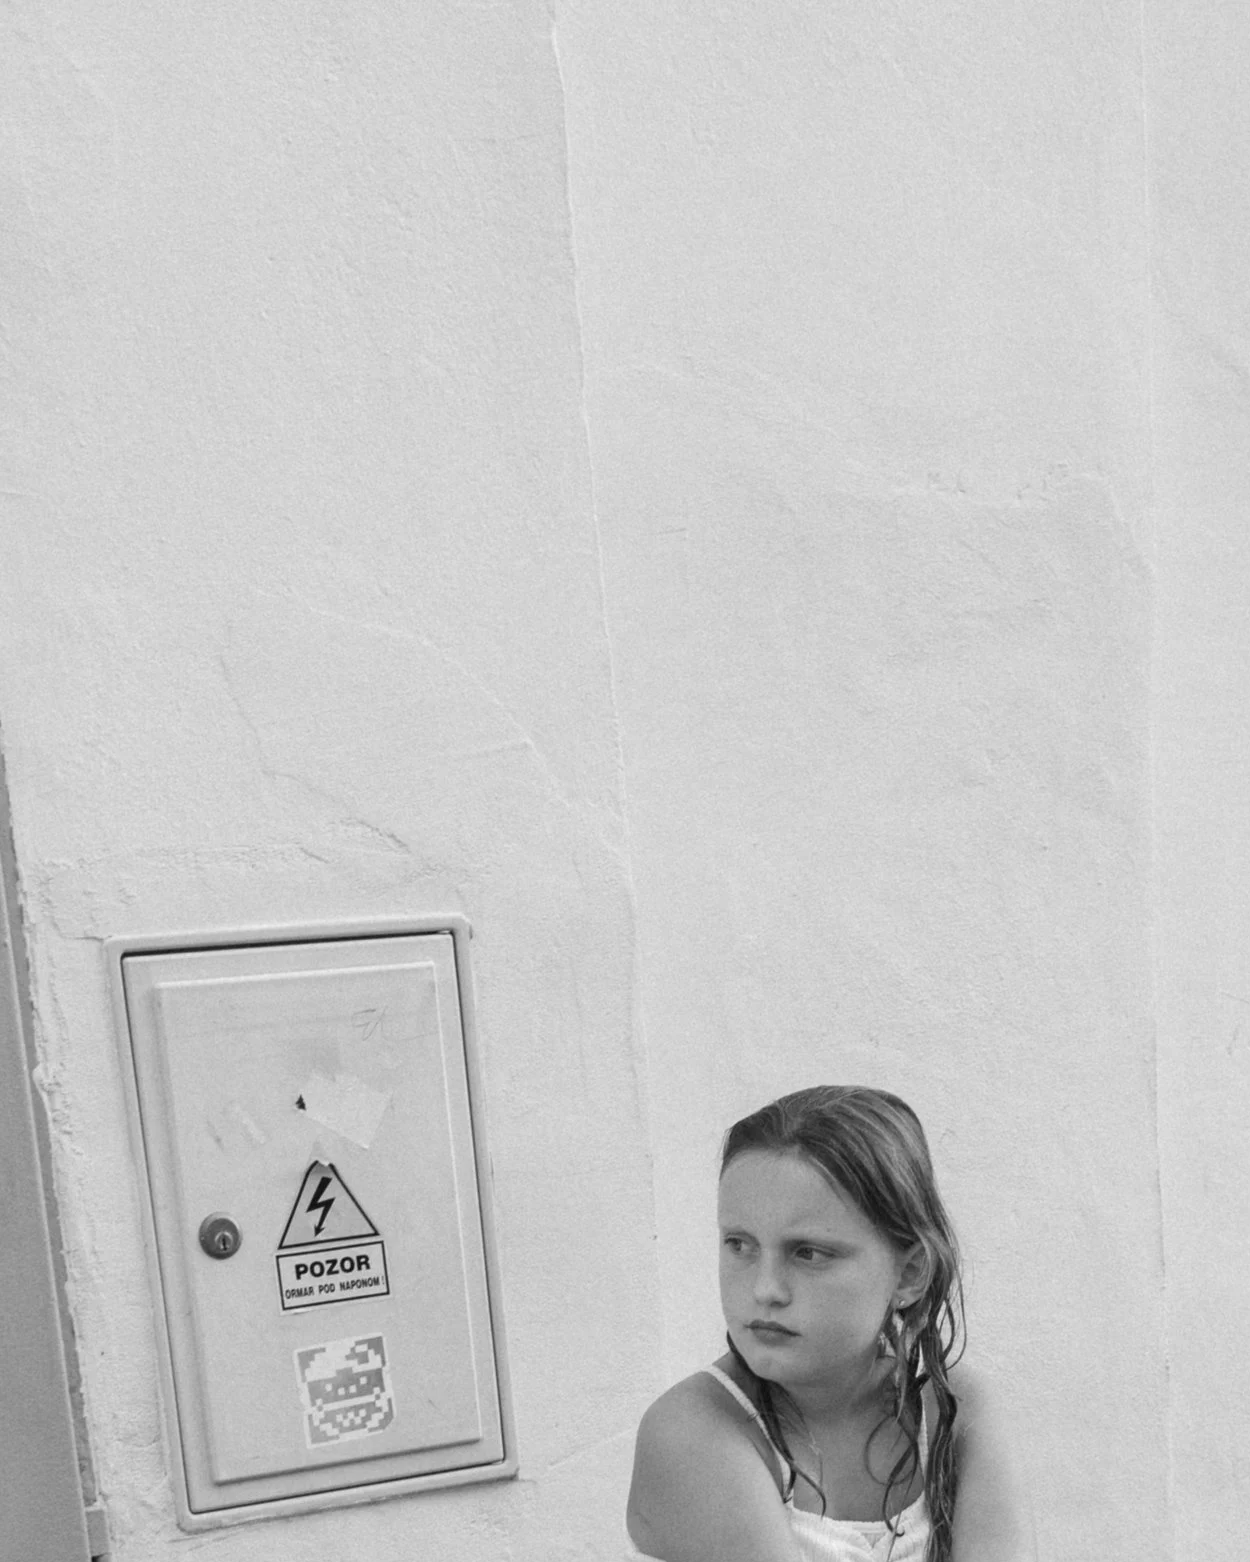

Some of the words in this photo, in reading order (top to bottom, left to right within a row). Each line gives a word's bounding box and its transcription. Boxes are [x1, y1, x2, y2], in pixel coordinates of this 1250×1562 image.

[295, 1254, 371, 1280] POZOR
[285, 1286, 315, 1299] ORMAR
[318, 1283, 336, 1294] POD
